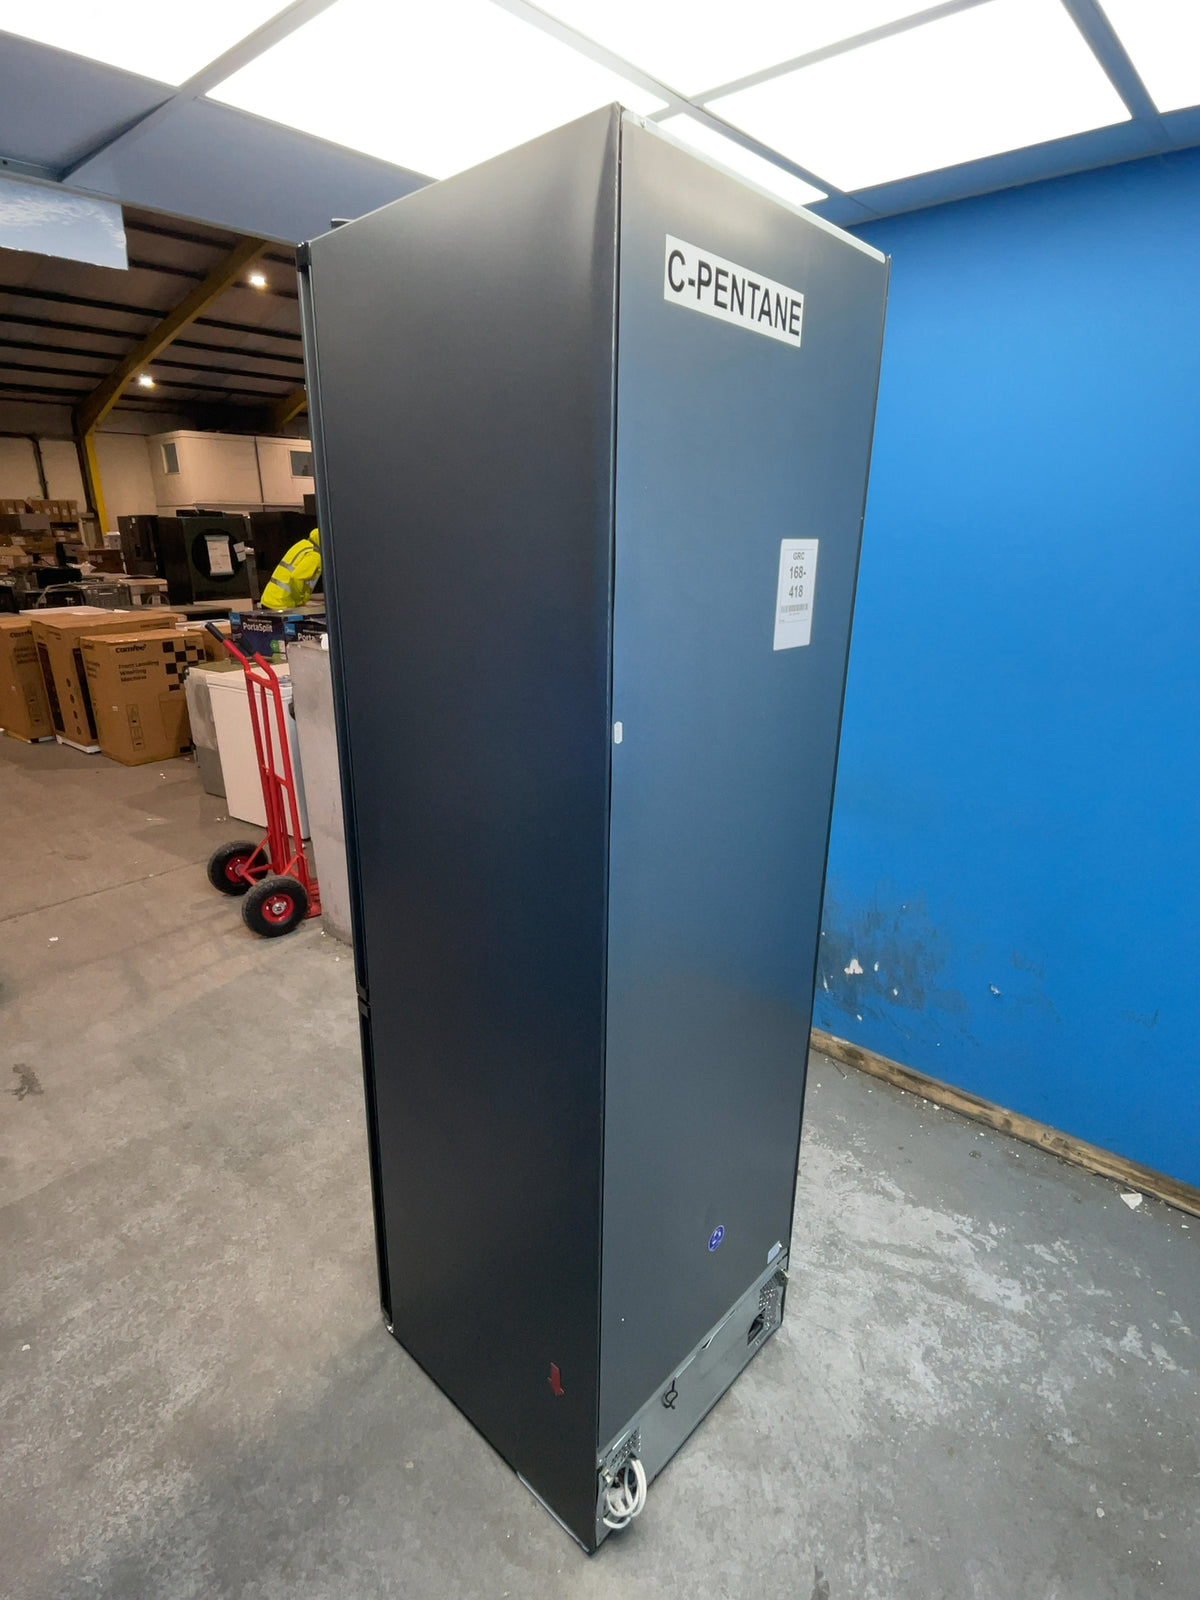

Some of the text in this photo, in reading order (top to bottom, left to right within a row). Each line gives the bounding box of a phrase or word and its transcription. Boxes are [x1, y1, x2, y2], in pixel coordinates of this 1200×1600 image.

[668, 249, 802, 337] C-PENTANE
[792, 551, 806, 561] GRC
[789, 566, 807, 579] 168-
[788, 585, 804, 598] 418
[243, 622, 273, 633] PortaSplit
